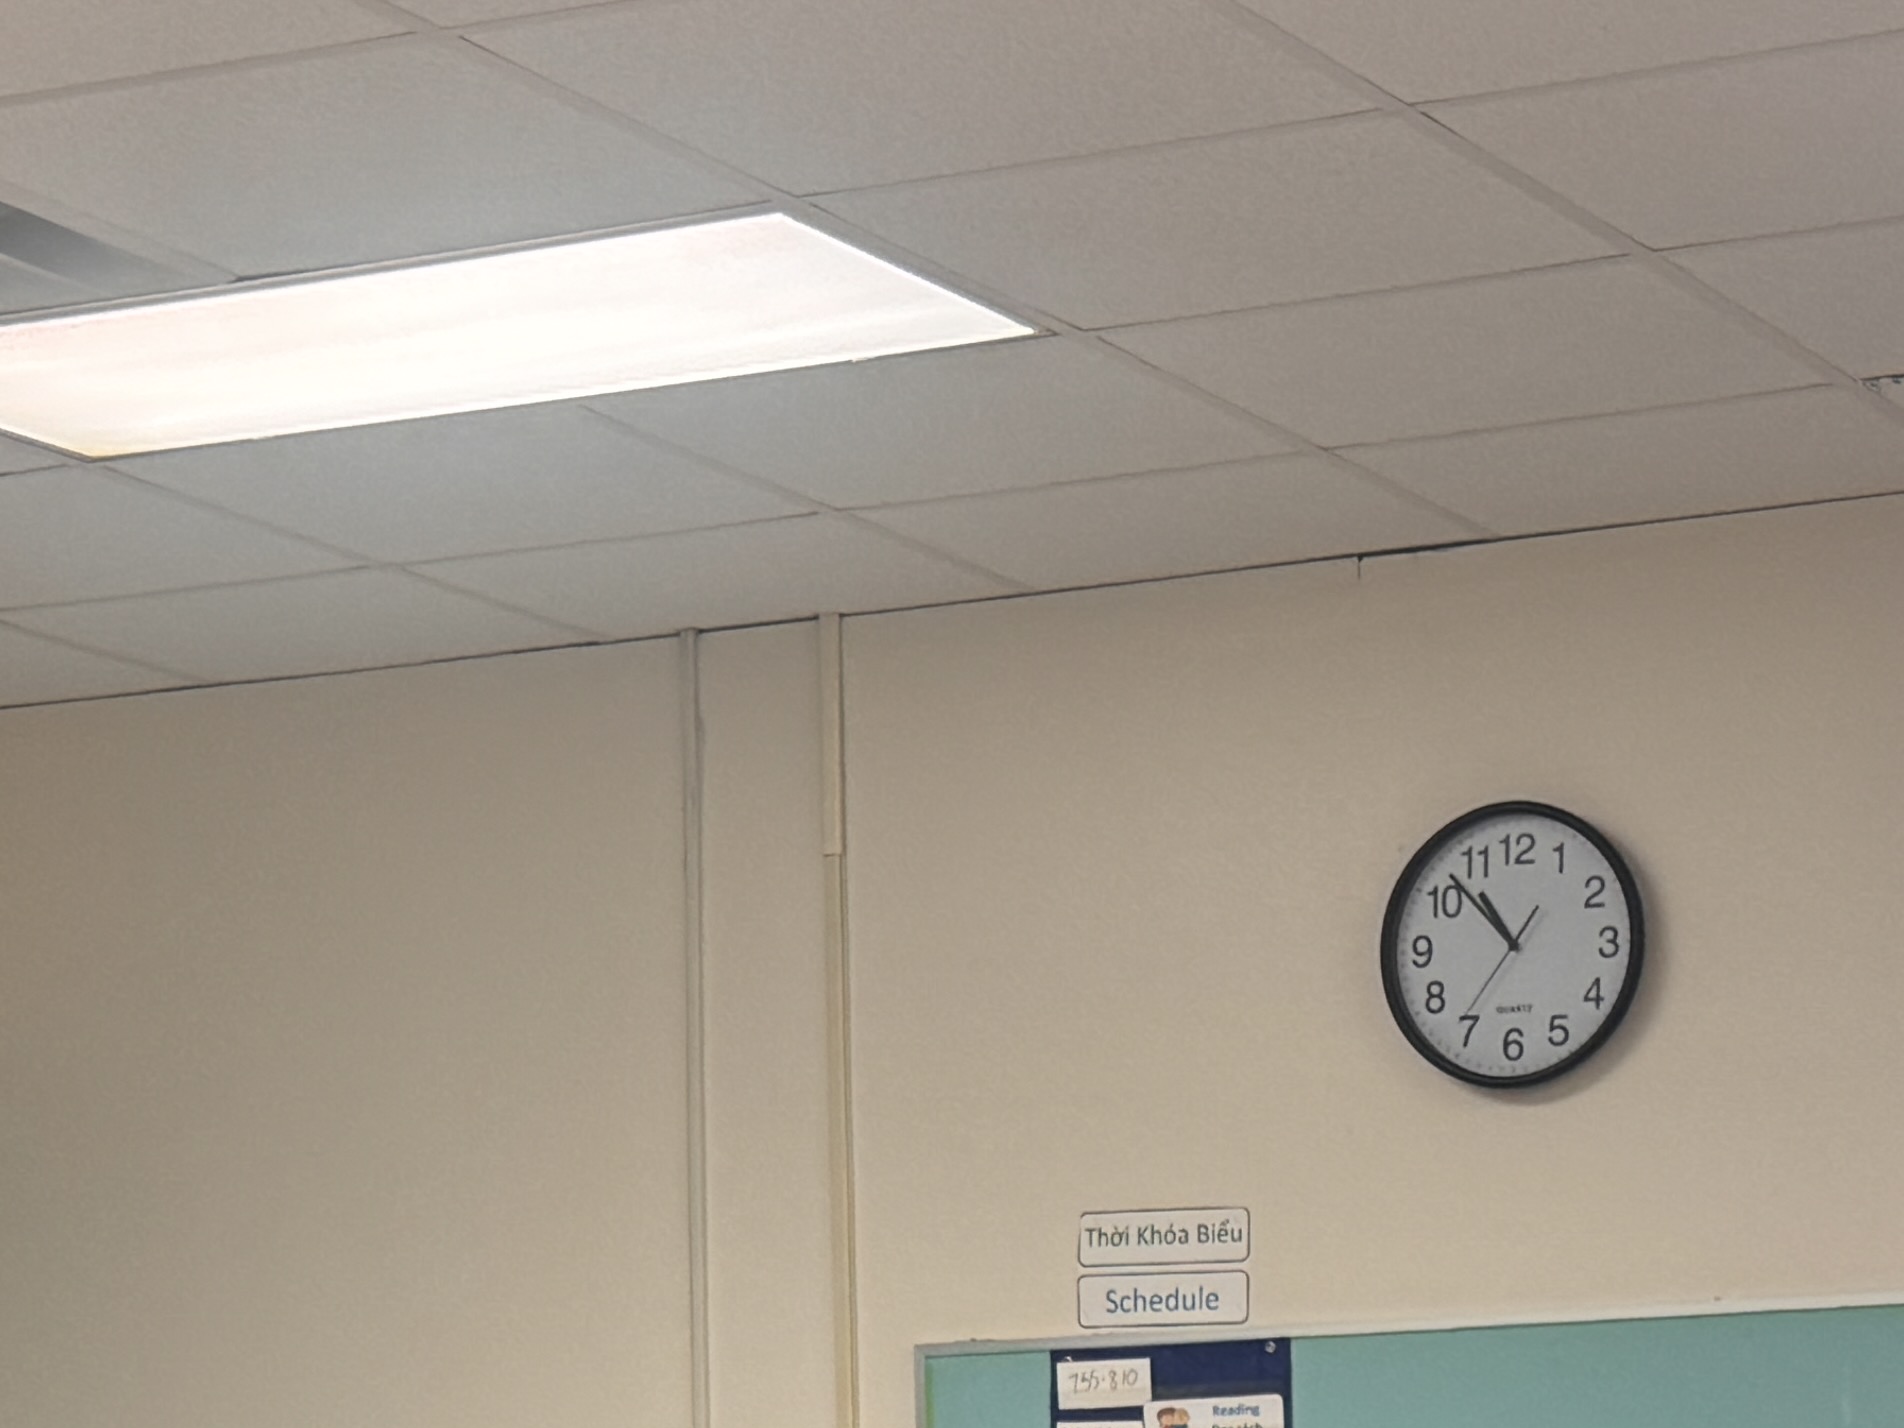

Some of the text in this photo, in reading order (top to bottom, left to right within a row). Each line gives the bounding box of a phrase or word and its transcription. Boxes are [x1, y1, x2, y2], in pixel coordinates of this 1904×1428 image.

[1460, 846, 1489, 879] 11
[1499, 833, 1536, 866] 12
[1552, 842, 1565, 874] 1
[1427, 885, 1463, 918] 10
[1584, 875, 1606, 909] 2
[1411, 935, 1433, 968] 9
[1598, 926, 1620, 958] 3
[1425, 981, 1446, 1014] 8
[1583, 977, 1604, 1010] 4
[1458, 1015, 1480, 1048] 7
[1502, 1028, 1524, 1061] 6
[1548, 1015, 1570, 1046] 5
[1085, 1219, 1243, 1248] Thời Khóa Biểu
[1106, 1286, 1220, 1314] Schedule
[1212, 1404, 1261, 1418] Reading
